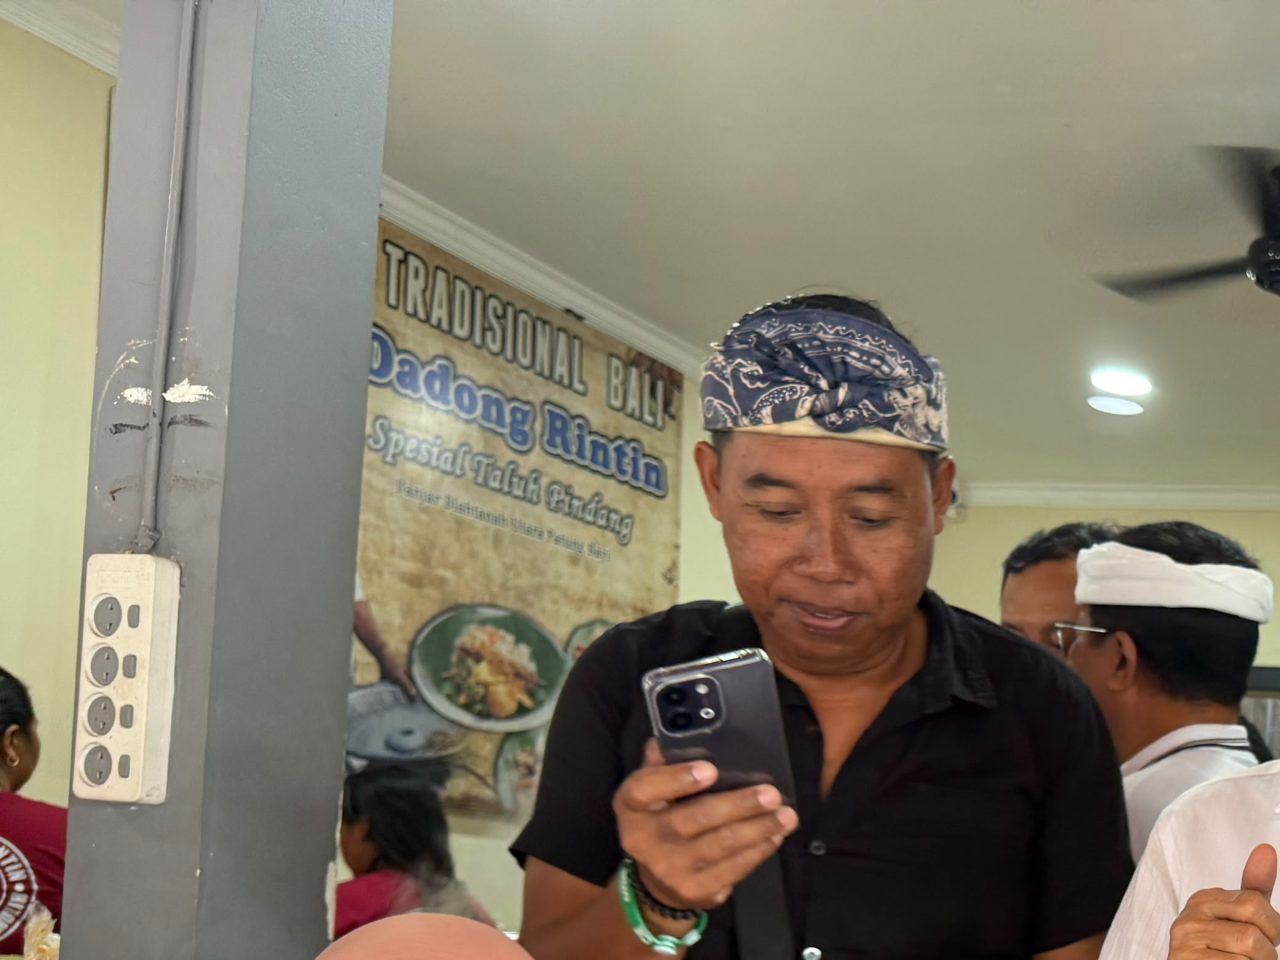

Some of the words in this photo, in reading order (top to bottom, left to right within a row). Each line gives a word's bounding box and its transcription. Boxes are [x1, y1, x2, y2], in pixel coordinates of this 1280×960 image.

[368, 323, 536, 452] Dadong
[541, 401, 669, 499] Rintin
[383, 239, 588, 396] TRADISIONAL
[606, 353, 666, 431] BALI
[366, 415, 470, 477] Spesial
[545, 479, 634, 546] Pindang
